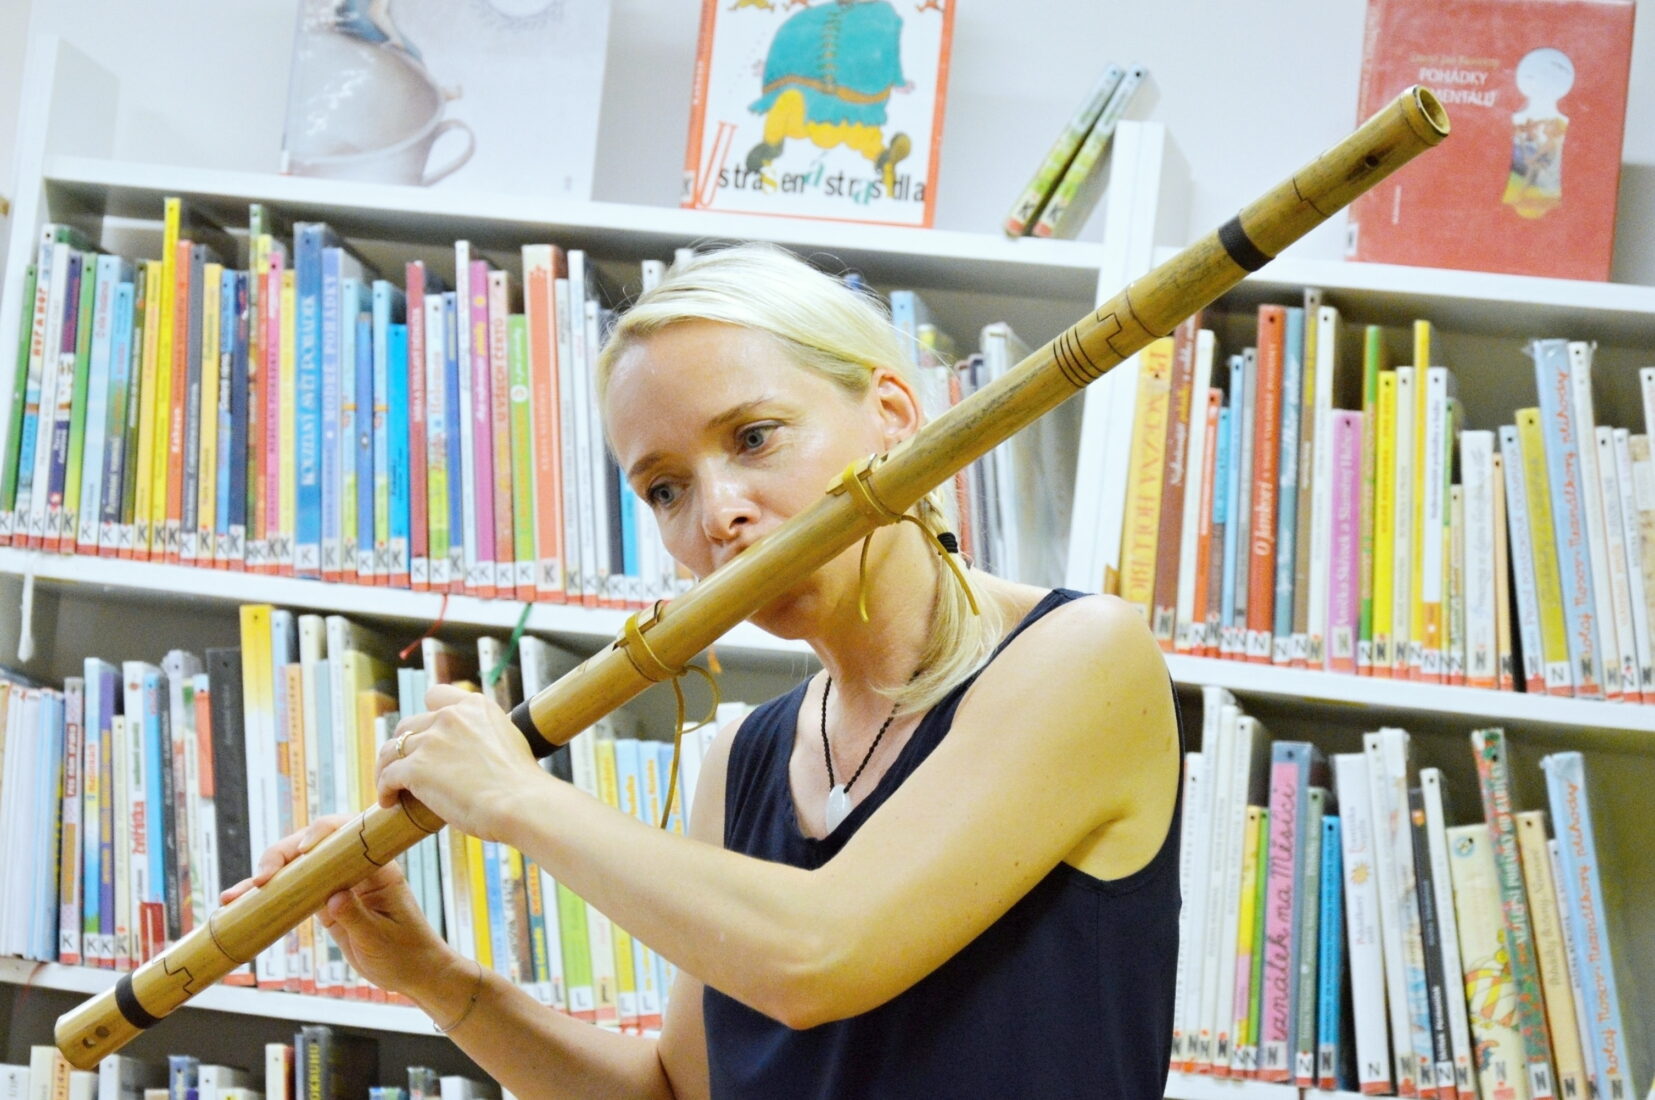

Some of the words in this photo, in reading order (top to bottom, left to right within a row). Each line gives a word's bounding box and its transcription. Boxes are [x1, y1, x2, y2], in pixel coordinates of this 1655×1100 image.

[62, 934, 73, 948] K
[87, 938, 98, 952] K
[102, 939, 112, 952] K
[117, 934, 128, 954] K
[266, 961, 276, 976] L
[287, 960, 296, 973] L
[329, 965, 340, 981] L
[317, 968, 327, 983] L
[576, 992, 587, 1007] L
[620, 997, 631, 1012] L
[643, 995, 653, 1010] L
